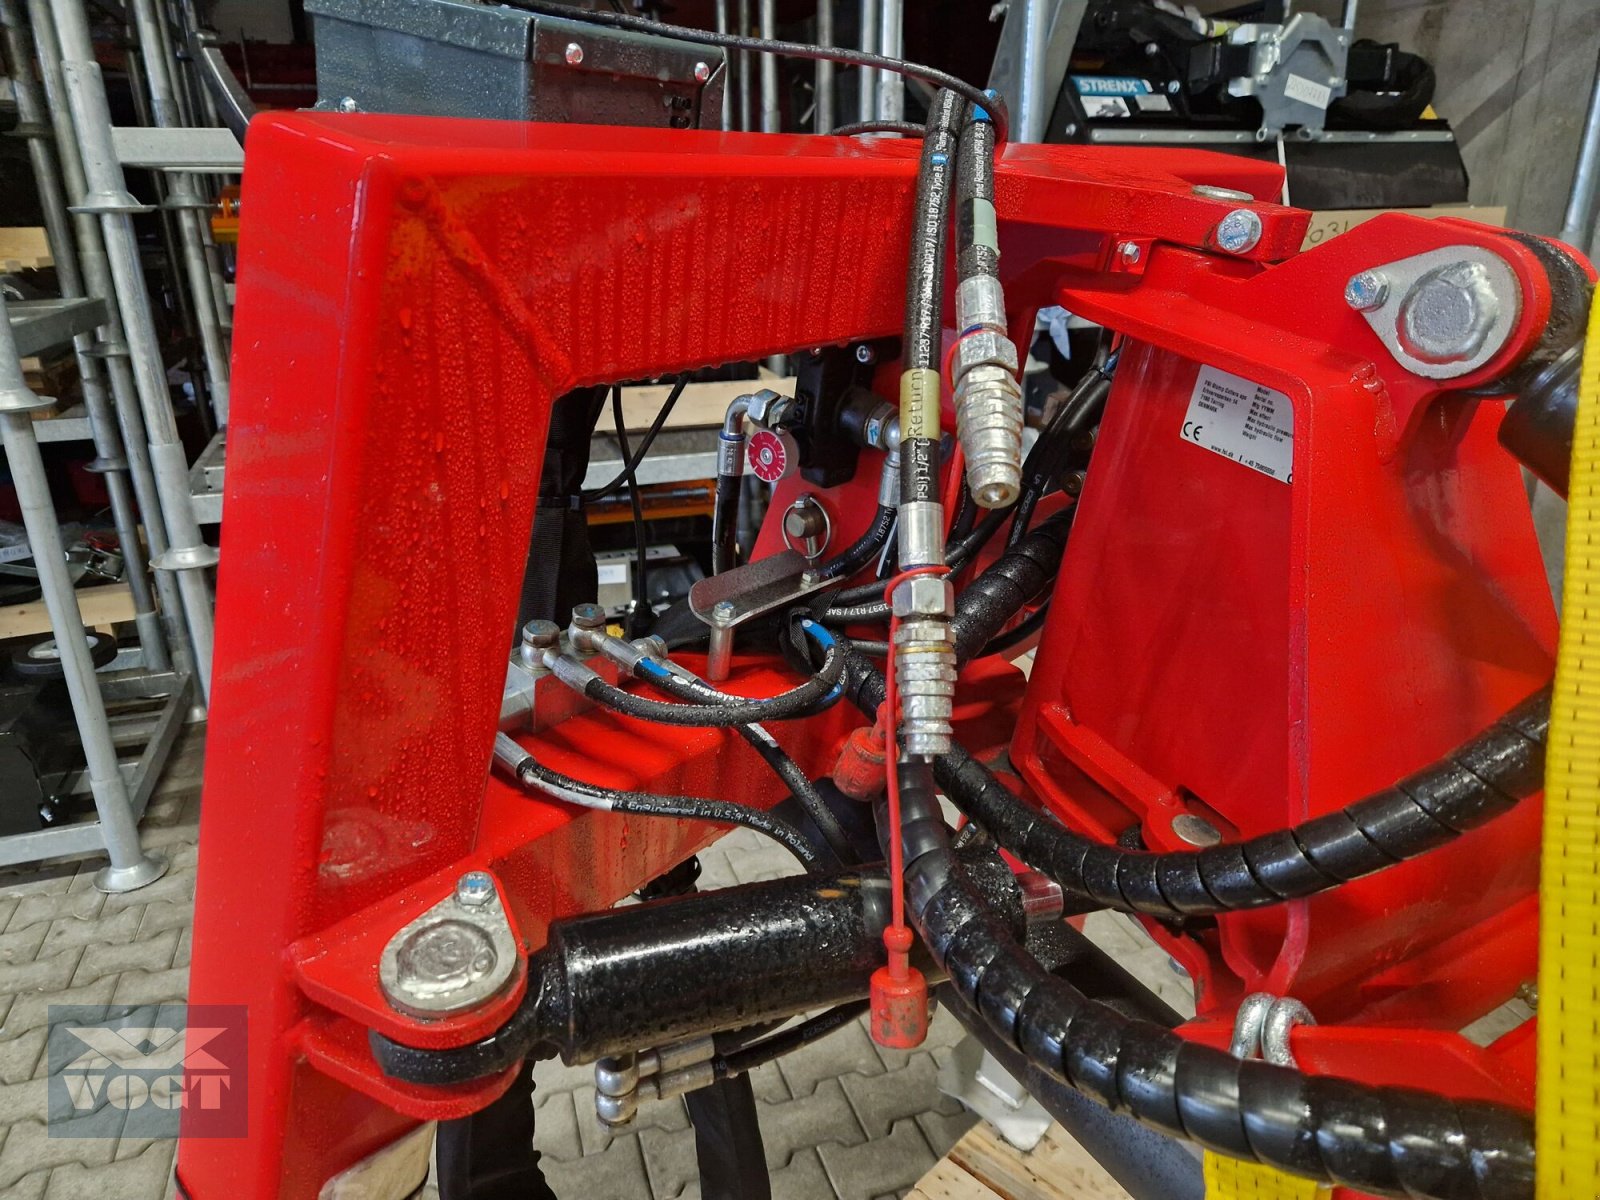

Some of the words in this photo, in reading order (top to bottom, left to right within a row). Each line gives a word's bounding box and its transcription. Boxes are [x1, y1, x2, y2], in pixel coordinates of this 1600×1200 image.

[1080, 79, 1138, 93] STRENX
[908, 371, 924, 437] Return
[1250, 408, 1258, 417] Max
[1247, 415, 1256, 424] Max
[1245, 422, 1254, 431] Max
[850, 607, 866, 616] R17
[700, 807, 712, 817] in
[774, 827, 785, 838] in
